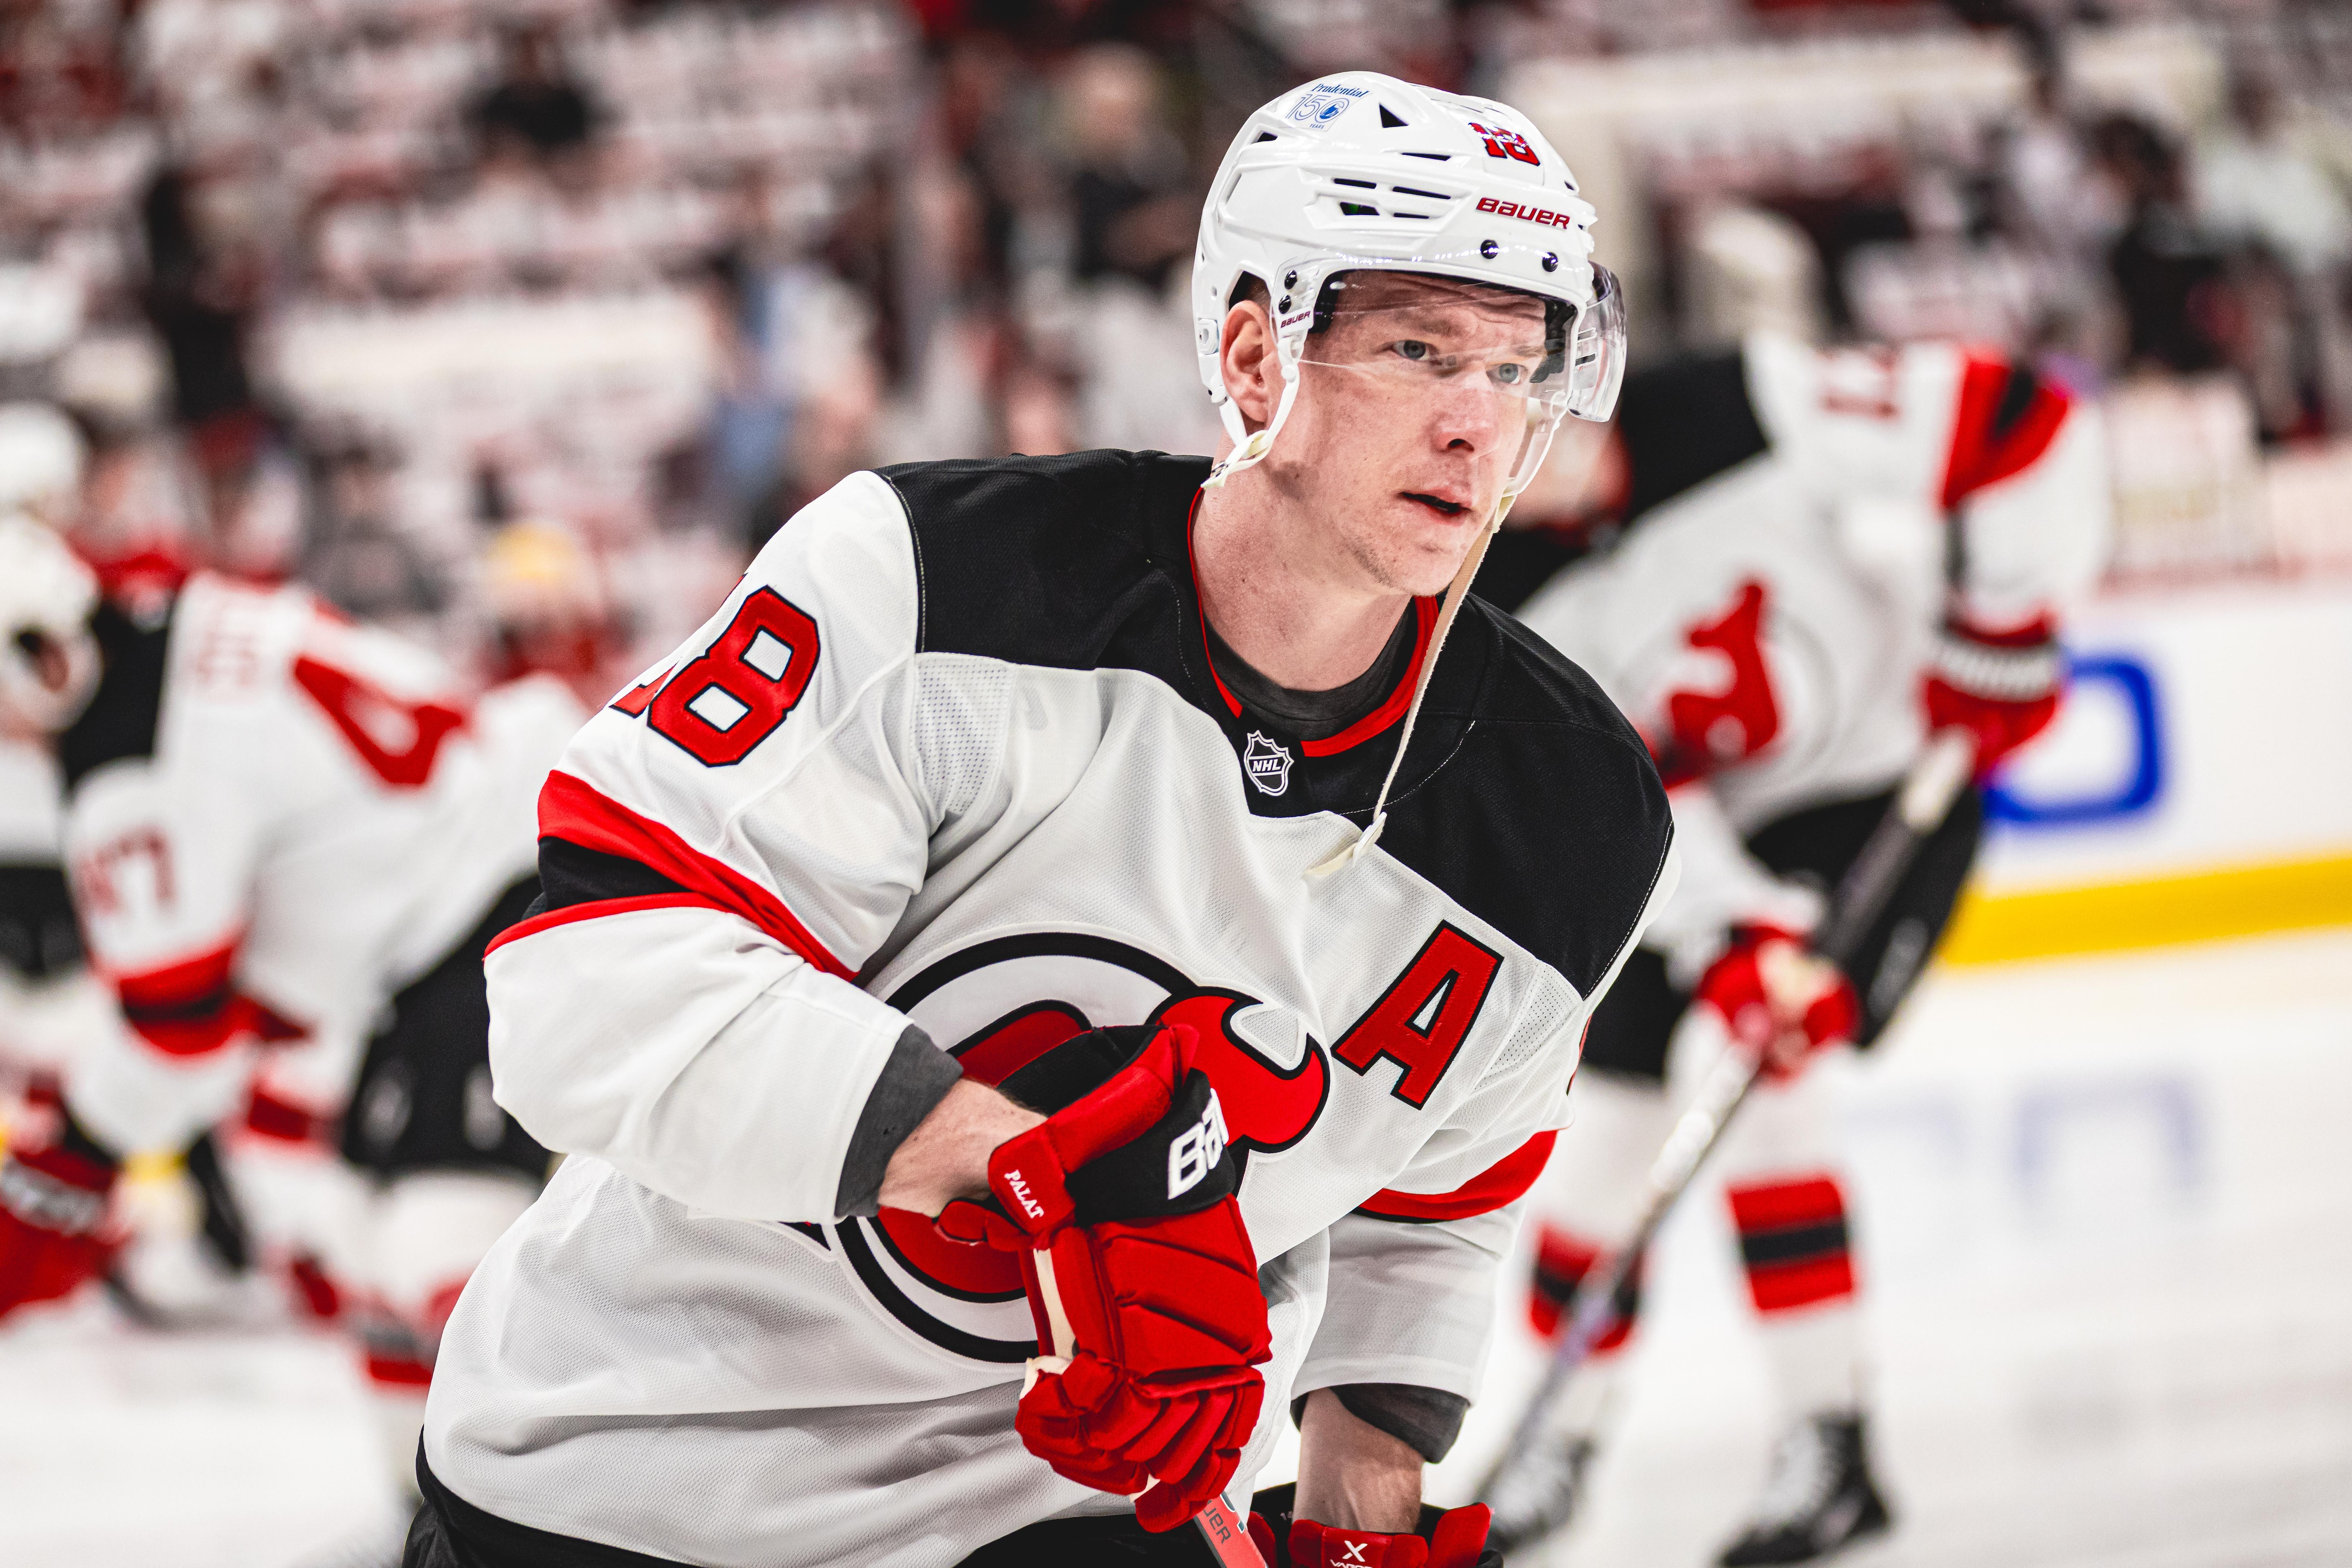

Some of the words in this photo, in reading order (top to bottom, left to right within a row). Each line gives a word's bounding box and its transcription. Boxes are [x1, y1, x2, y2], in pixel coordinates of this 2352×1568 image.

[1311, 83, 1369, 97] Prudential
[1468, 122, 1541, 167] 18
[1476, 197, 1570, 229] BAUER
[1252, 759, 1281, 772] NHL
[1331, 919, 1504, 1111] A
[1004, 1169, 1044, 1219] PALAT
